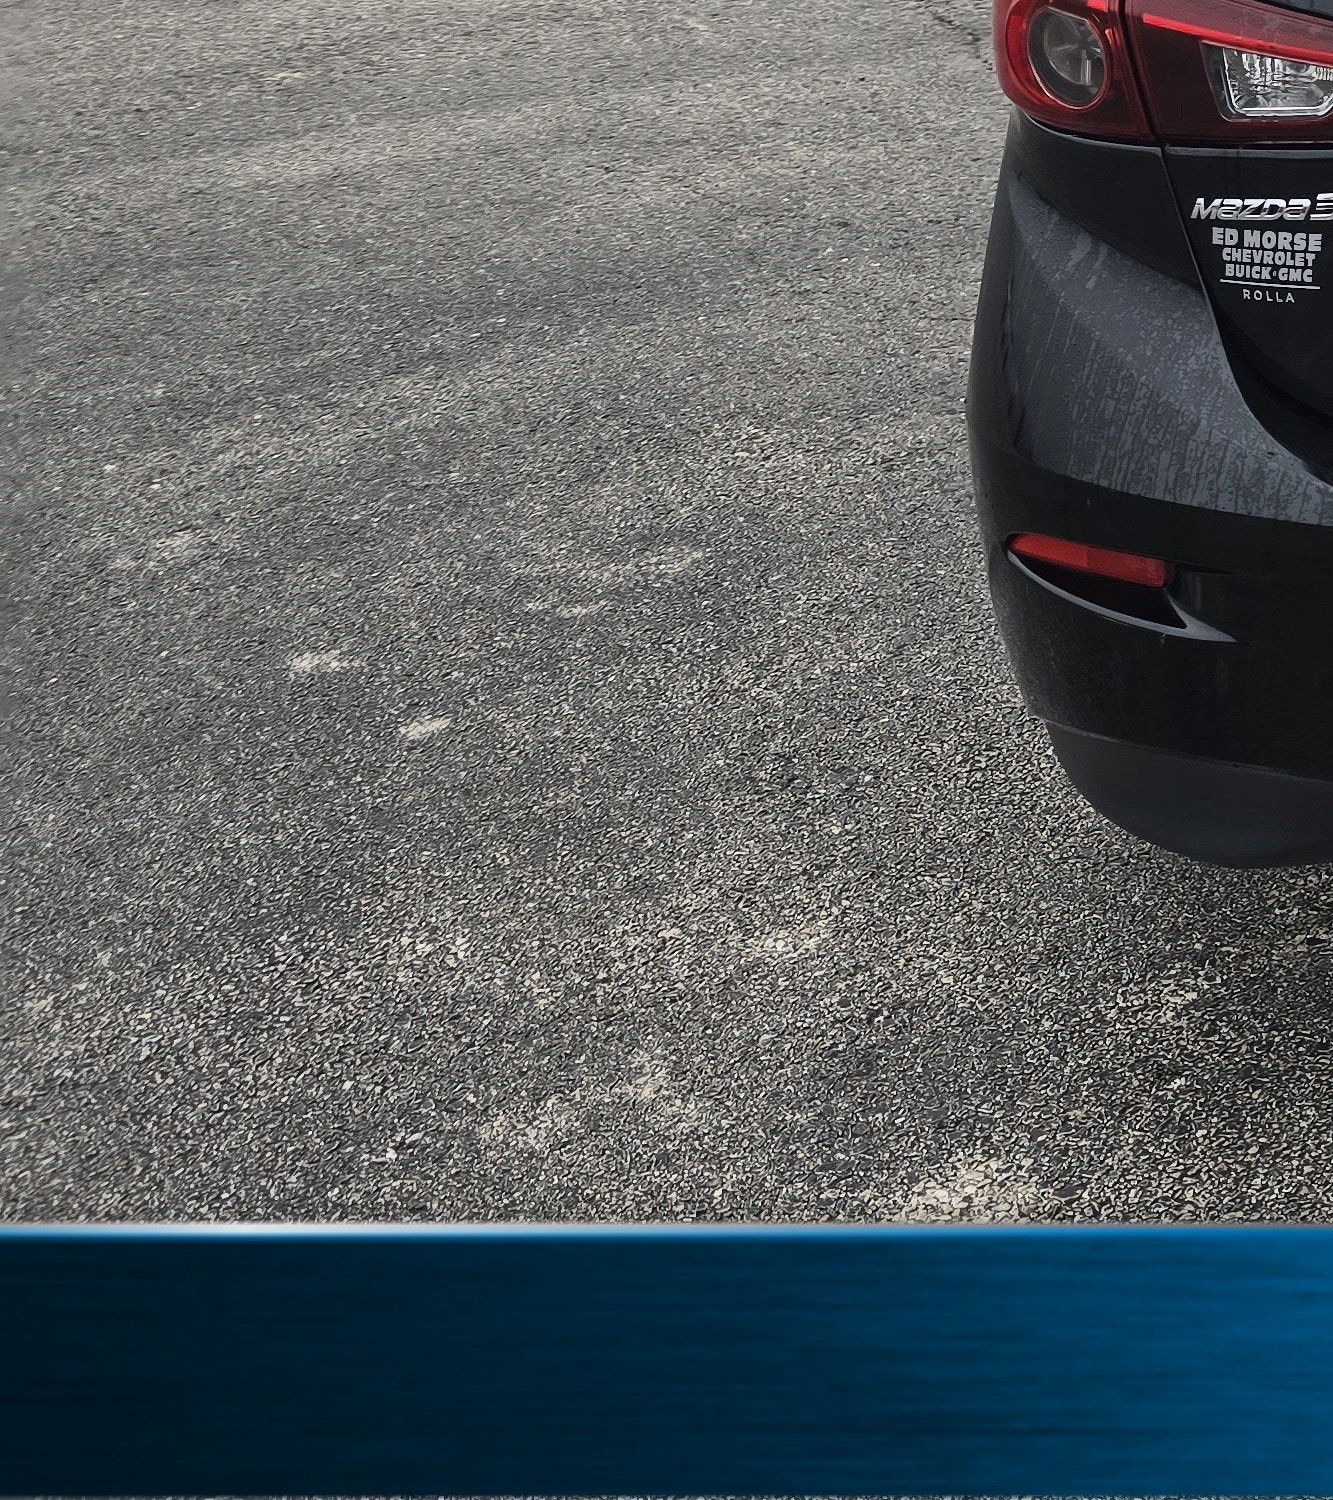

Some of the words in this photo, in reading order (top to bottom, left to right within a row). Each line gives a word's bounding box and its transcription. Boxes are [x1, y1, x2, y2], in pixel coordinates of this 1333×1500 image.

[1212, 226, 1239, 246] ED
[1243, 229, 1323, 252] MORSE
[1222, 247, 1316, 267] CHEVROLET
[1242, 288, 1295, 303] ROLLA
